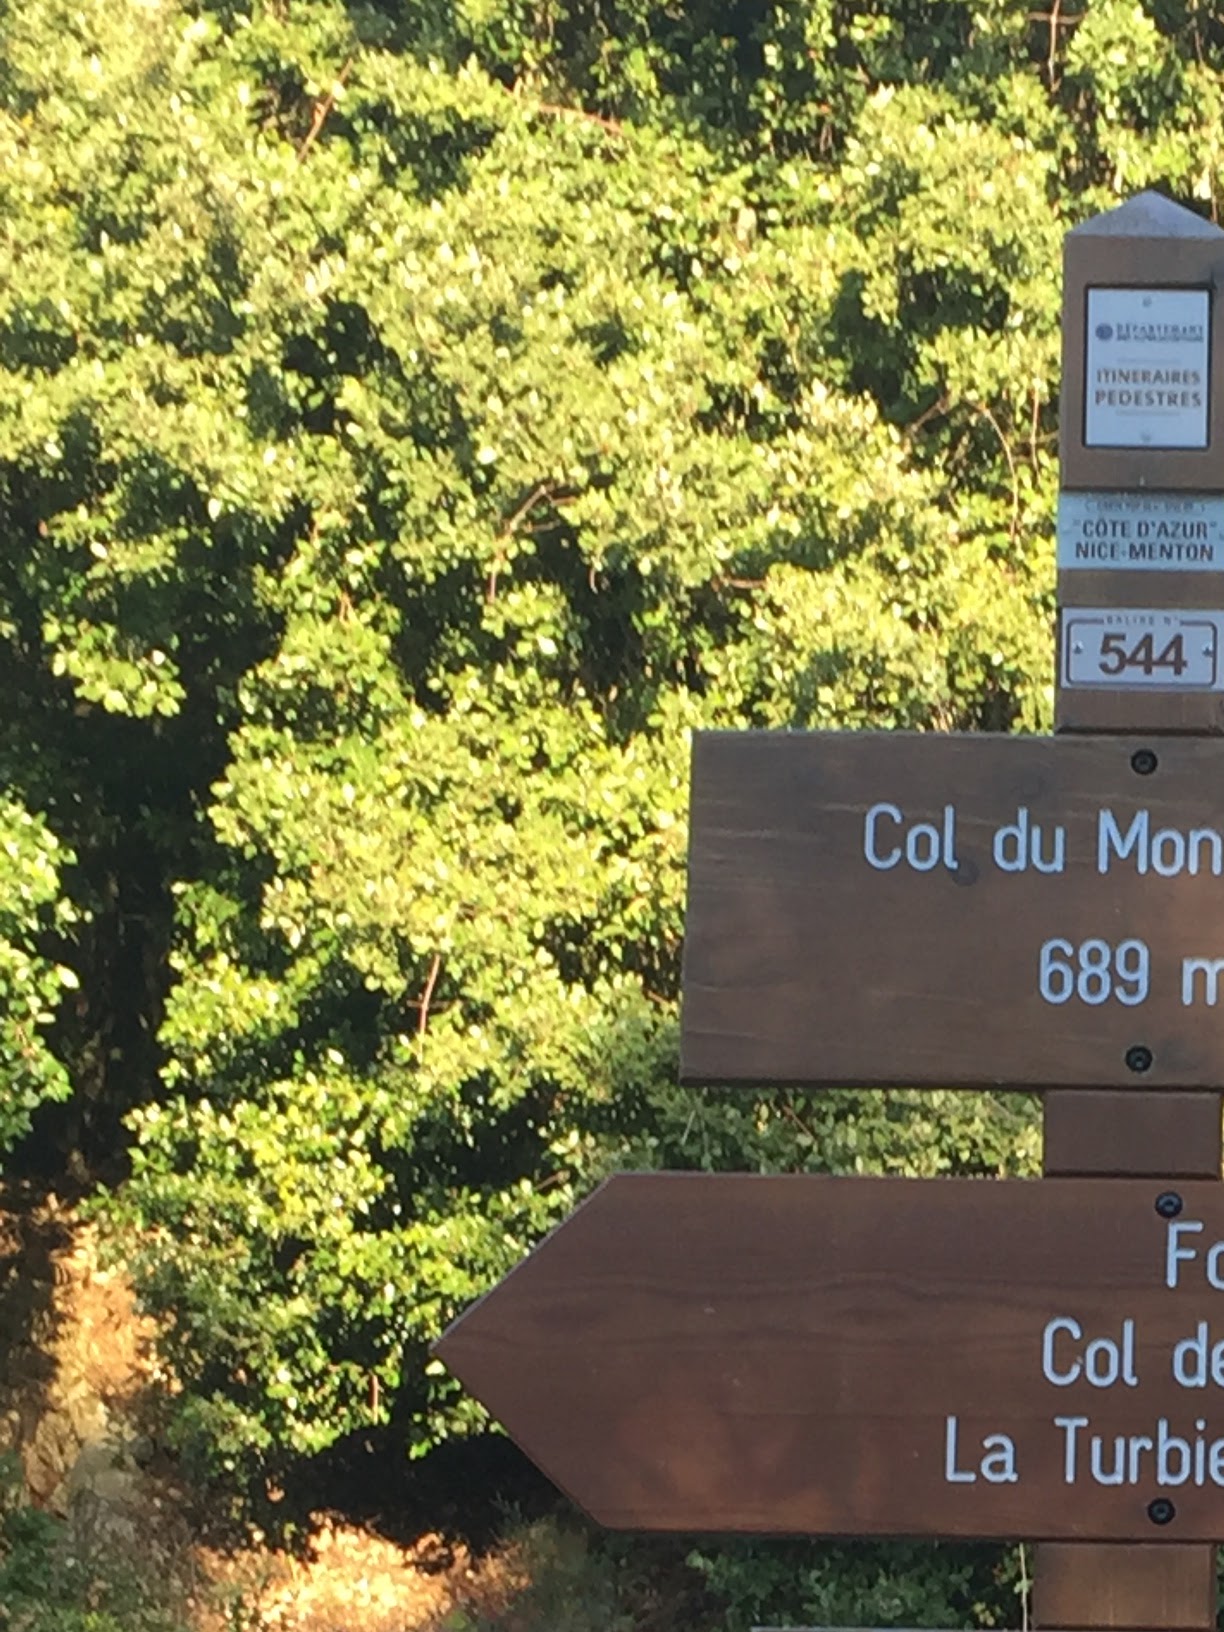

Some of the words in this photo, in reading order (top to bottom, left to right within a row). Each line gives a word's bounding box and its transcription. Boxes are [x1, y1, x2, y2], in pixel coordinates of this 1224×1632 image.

[1099, 632, 1187, 676] 544
[864, 803, 958, 871] Col
[993, 806, 1065, 873] du
[1039, 938, 1149, 1006] 689
[1042, 1317, 1138, 1387] Col
[945, 1415, 1019, 1483] La
